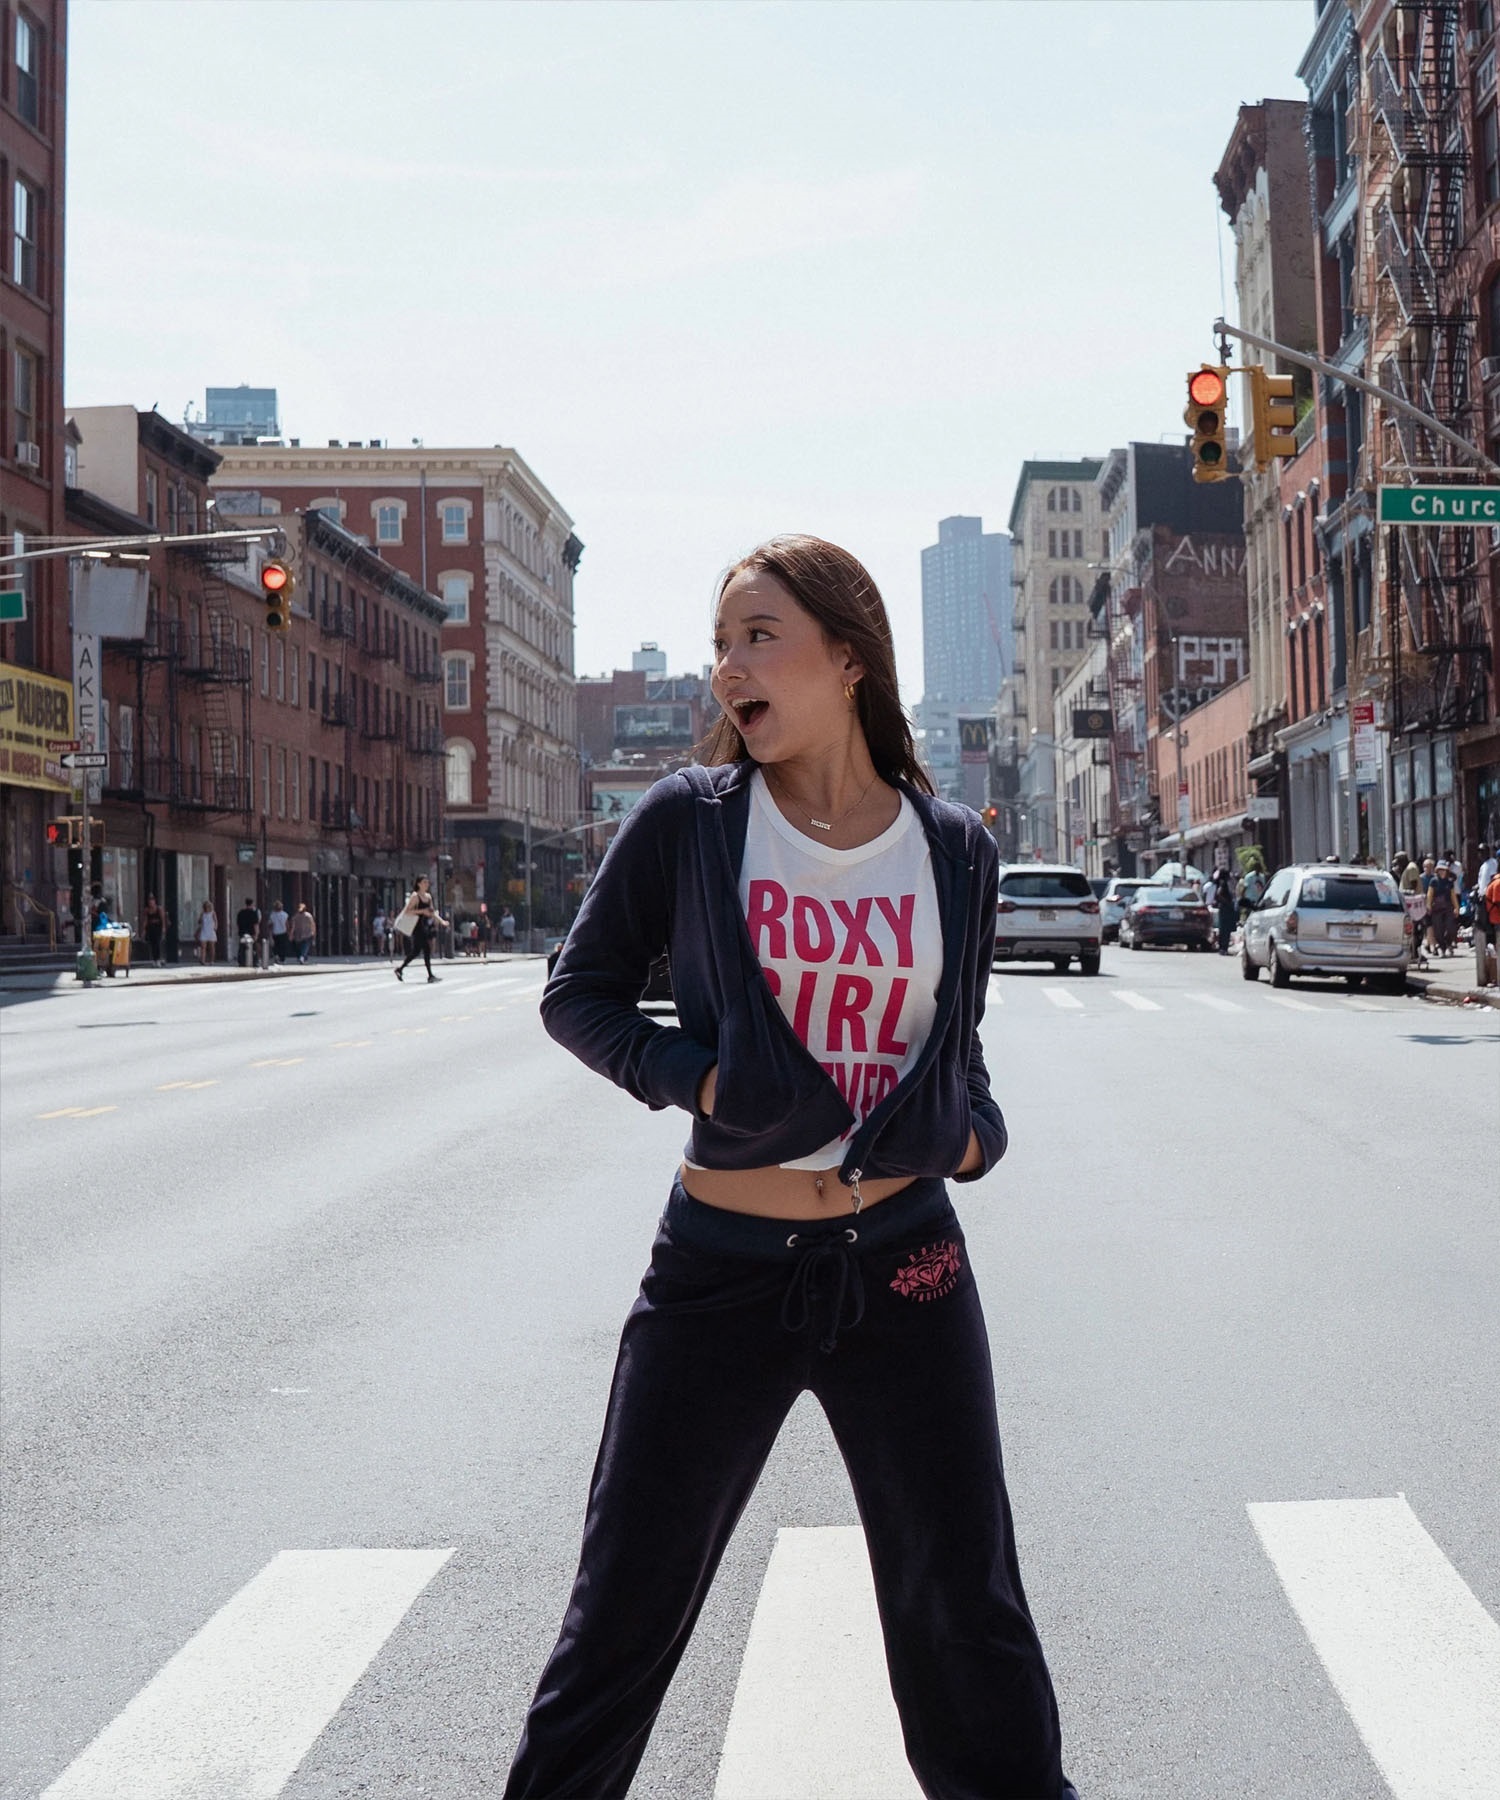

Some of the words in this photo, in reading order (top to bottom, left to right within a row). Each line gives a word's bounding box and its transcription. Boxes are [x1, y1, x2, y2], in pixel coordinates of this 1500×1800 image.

[17, 679, 69, 735] RUBBER
[89, 756, 103, 764] WAY
[747, 879, 916, 968] ROXY
